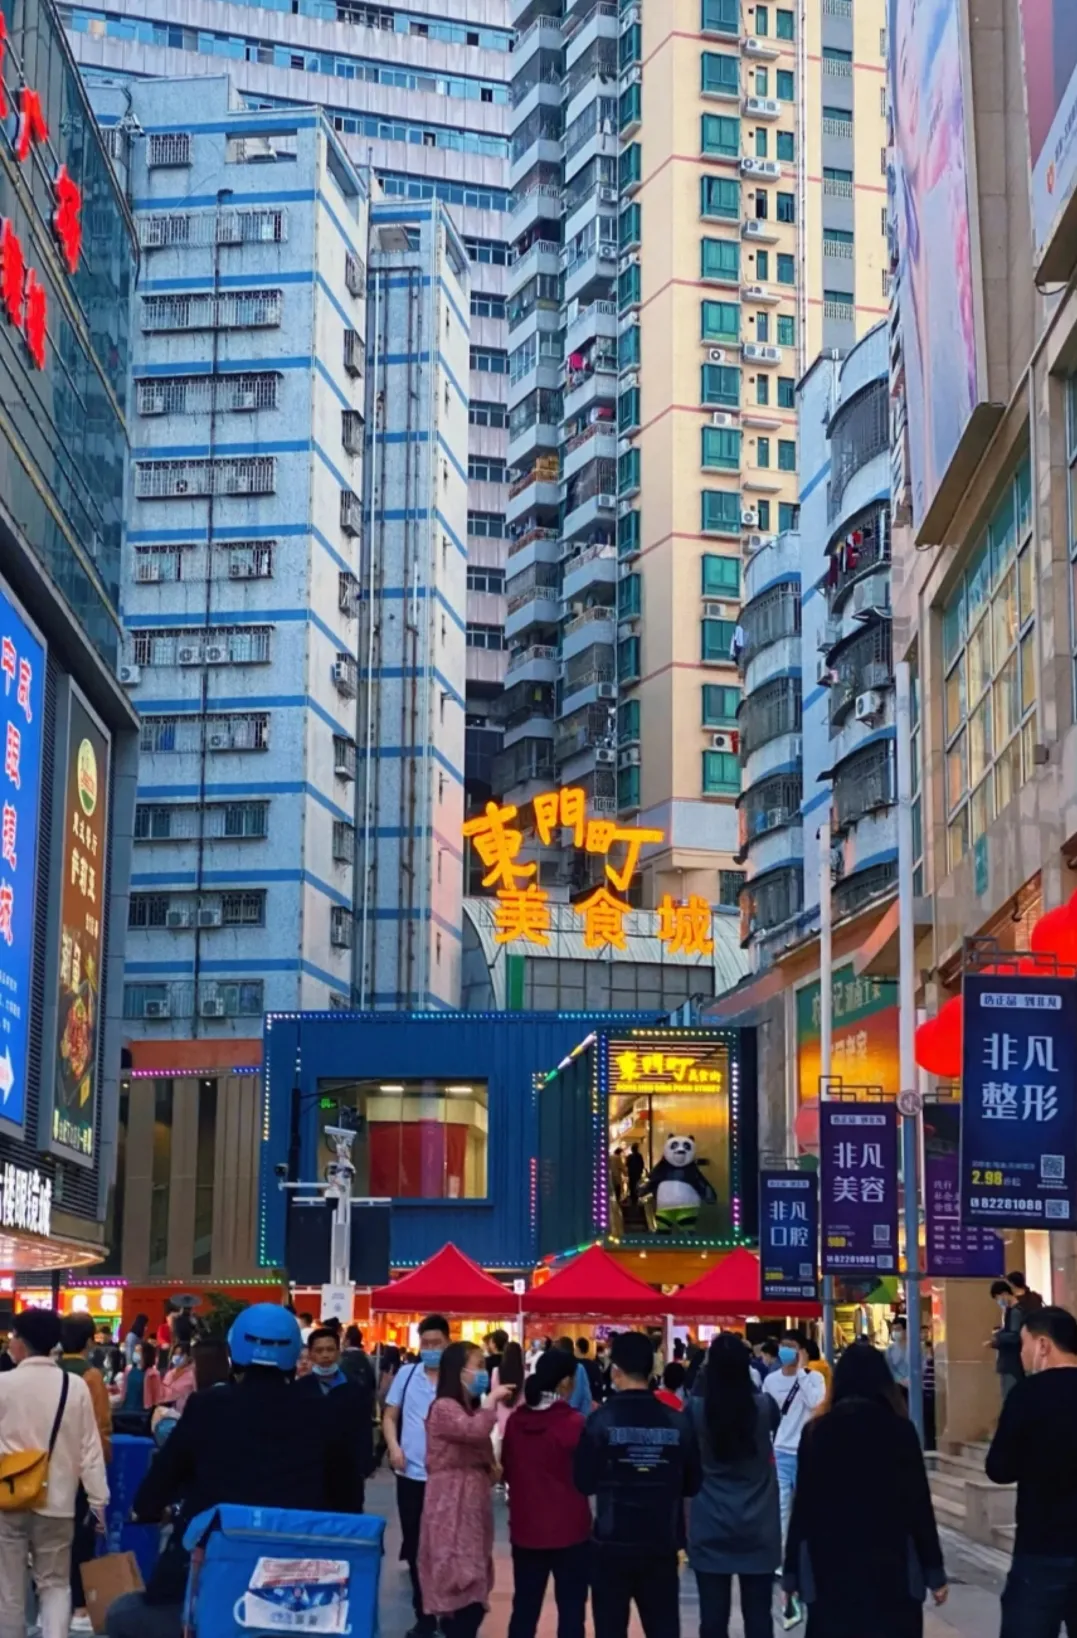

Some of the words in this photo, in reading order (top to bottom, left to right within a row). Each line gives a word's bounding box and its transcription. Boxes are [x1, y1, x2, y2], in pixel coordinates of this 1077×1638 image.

[462, 786, 664, 891] 東門町
[494, 884, 714, 956] 美食城
[982, 1032, 1060, 1072] 非凡
[981, 1081, 1059, 1122] 整形
[833, 1142, 885, 1169] 非凡
[833, 1176, 885, 1203] 美容
[769, 1200, 809, 1221] 非凡
[770, 1227, 809, 1247] 口腔
